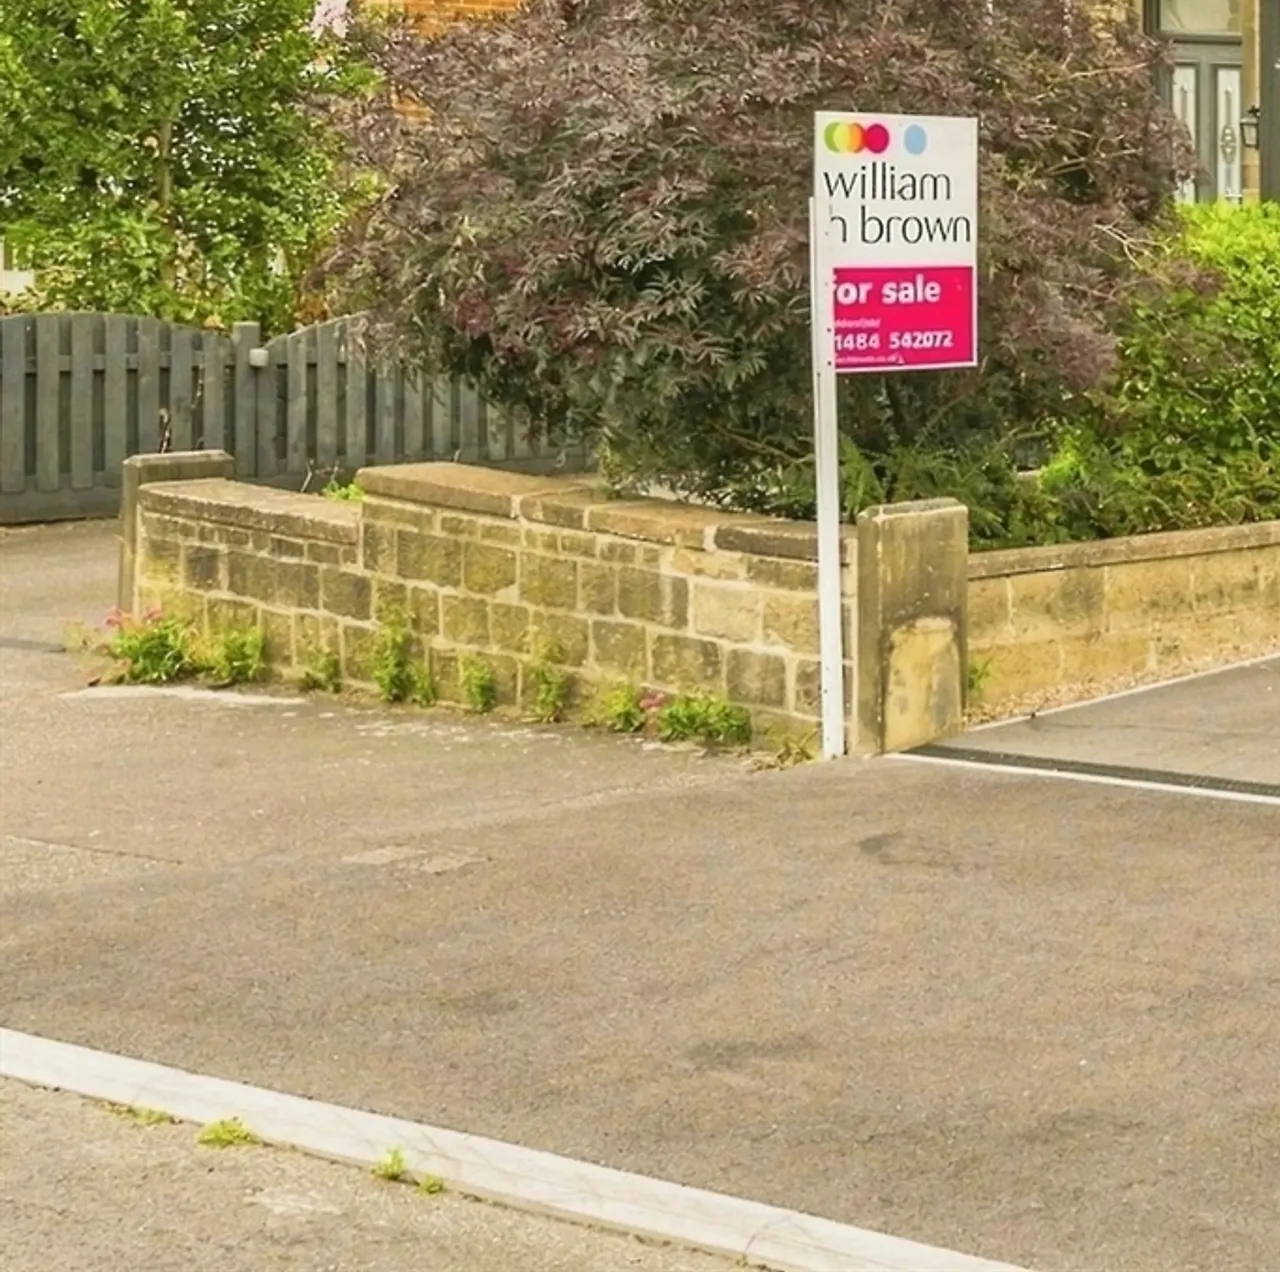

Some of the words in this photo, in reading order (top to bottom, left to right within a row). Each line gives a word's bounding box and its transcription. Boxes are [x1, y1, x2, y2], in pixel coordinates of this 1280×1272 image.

[823, 162, 951, 201] william
[861, 204, 971, 244] brown
[881, 274, 941, 304] sale
[889, 330, 954, 349] 542072
